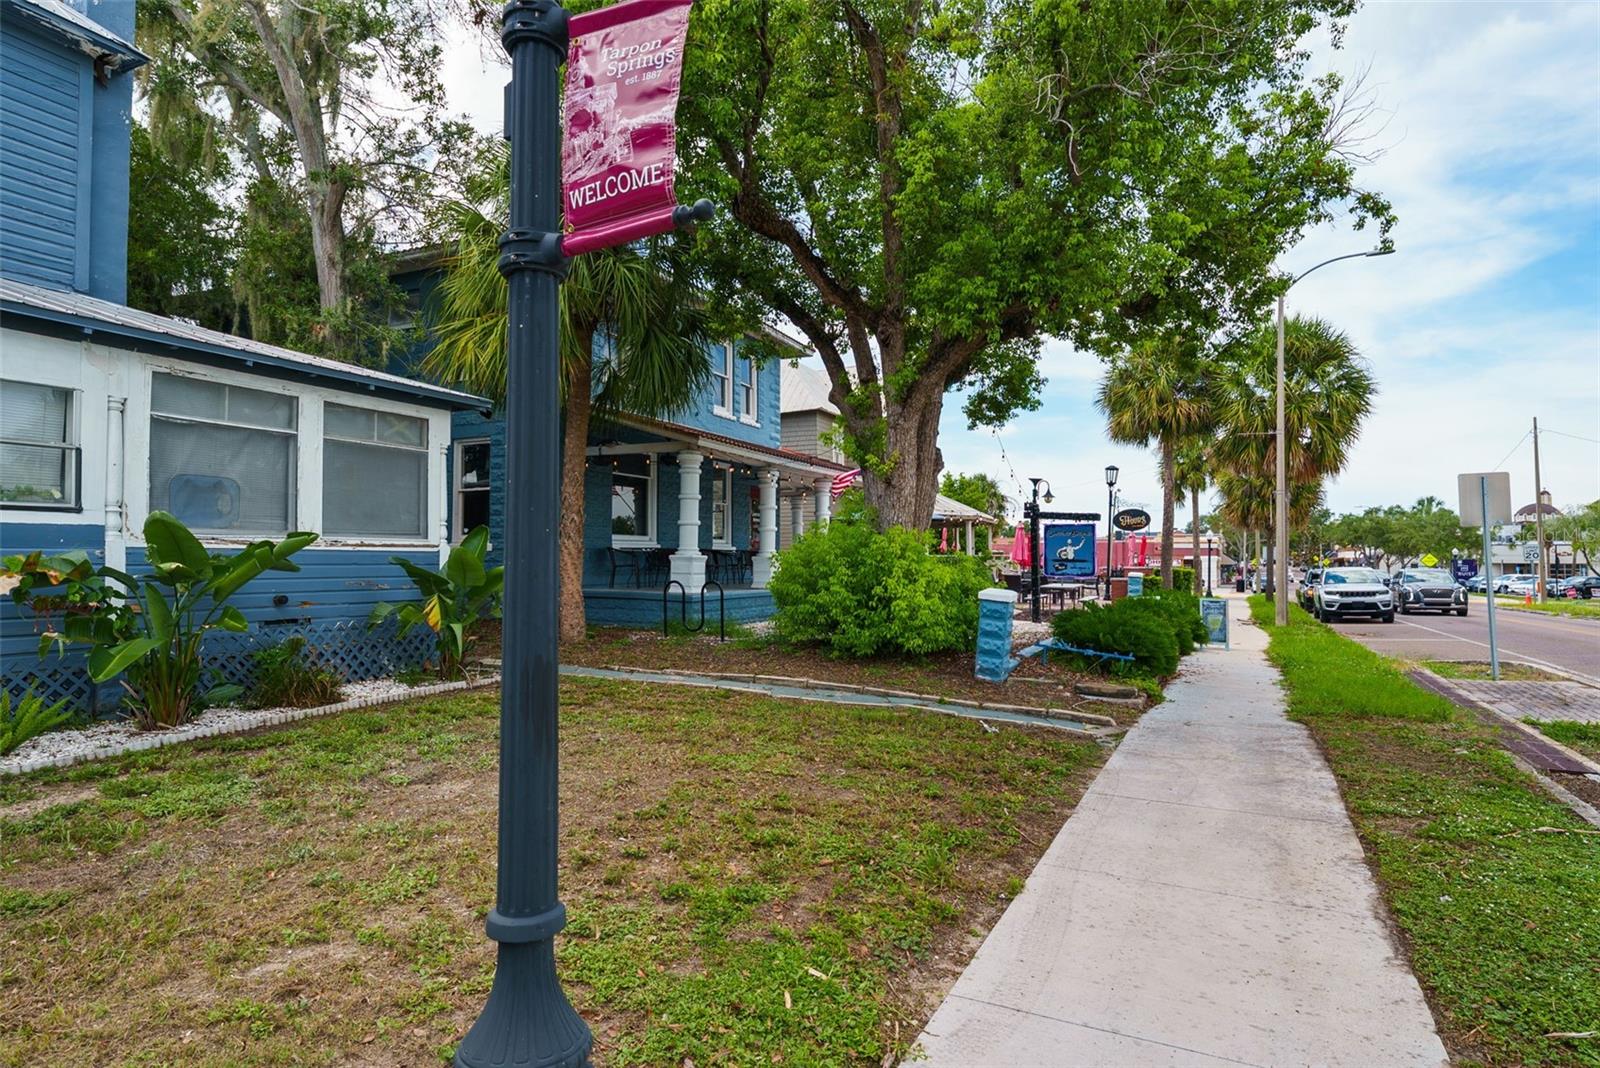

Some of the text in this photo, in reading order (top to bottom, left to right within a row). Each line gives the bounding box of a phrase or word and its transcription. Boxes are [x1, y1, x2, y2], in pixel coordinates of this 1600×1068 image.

[601, 39, 662, 63] Tarpon
[606, 49, 676, 78] Springs
[625, 71, 662, 85] est. 1887
[569, 163, 664, 209] WELCOME
